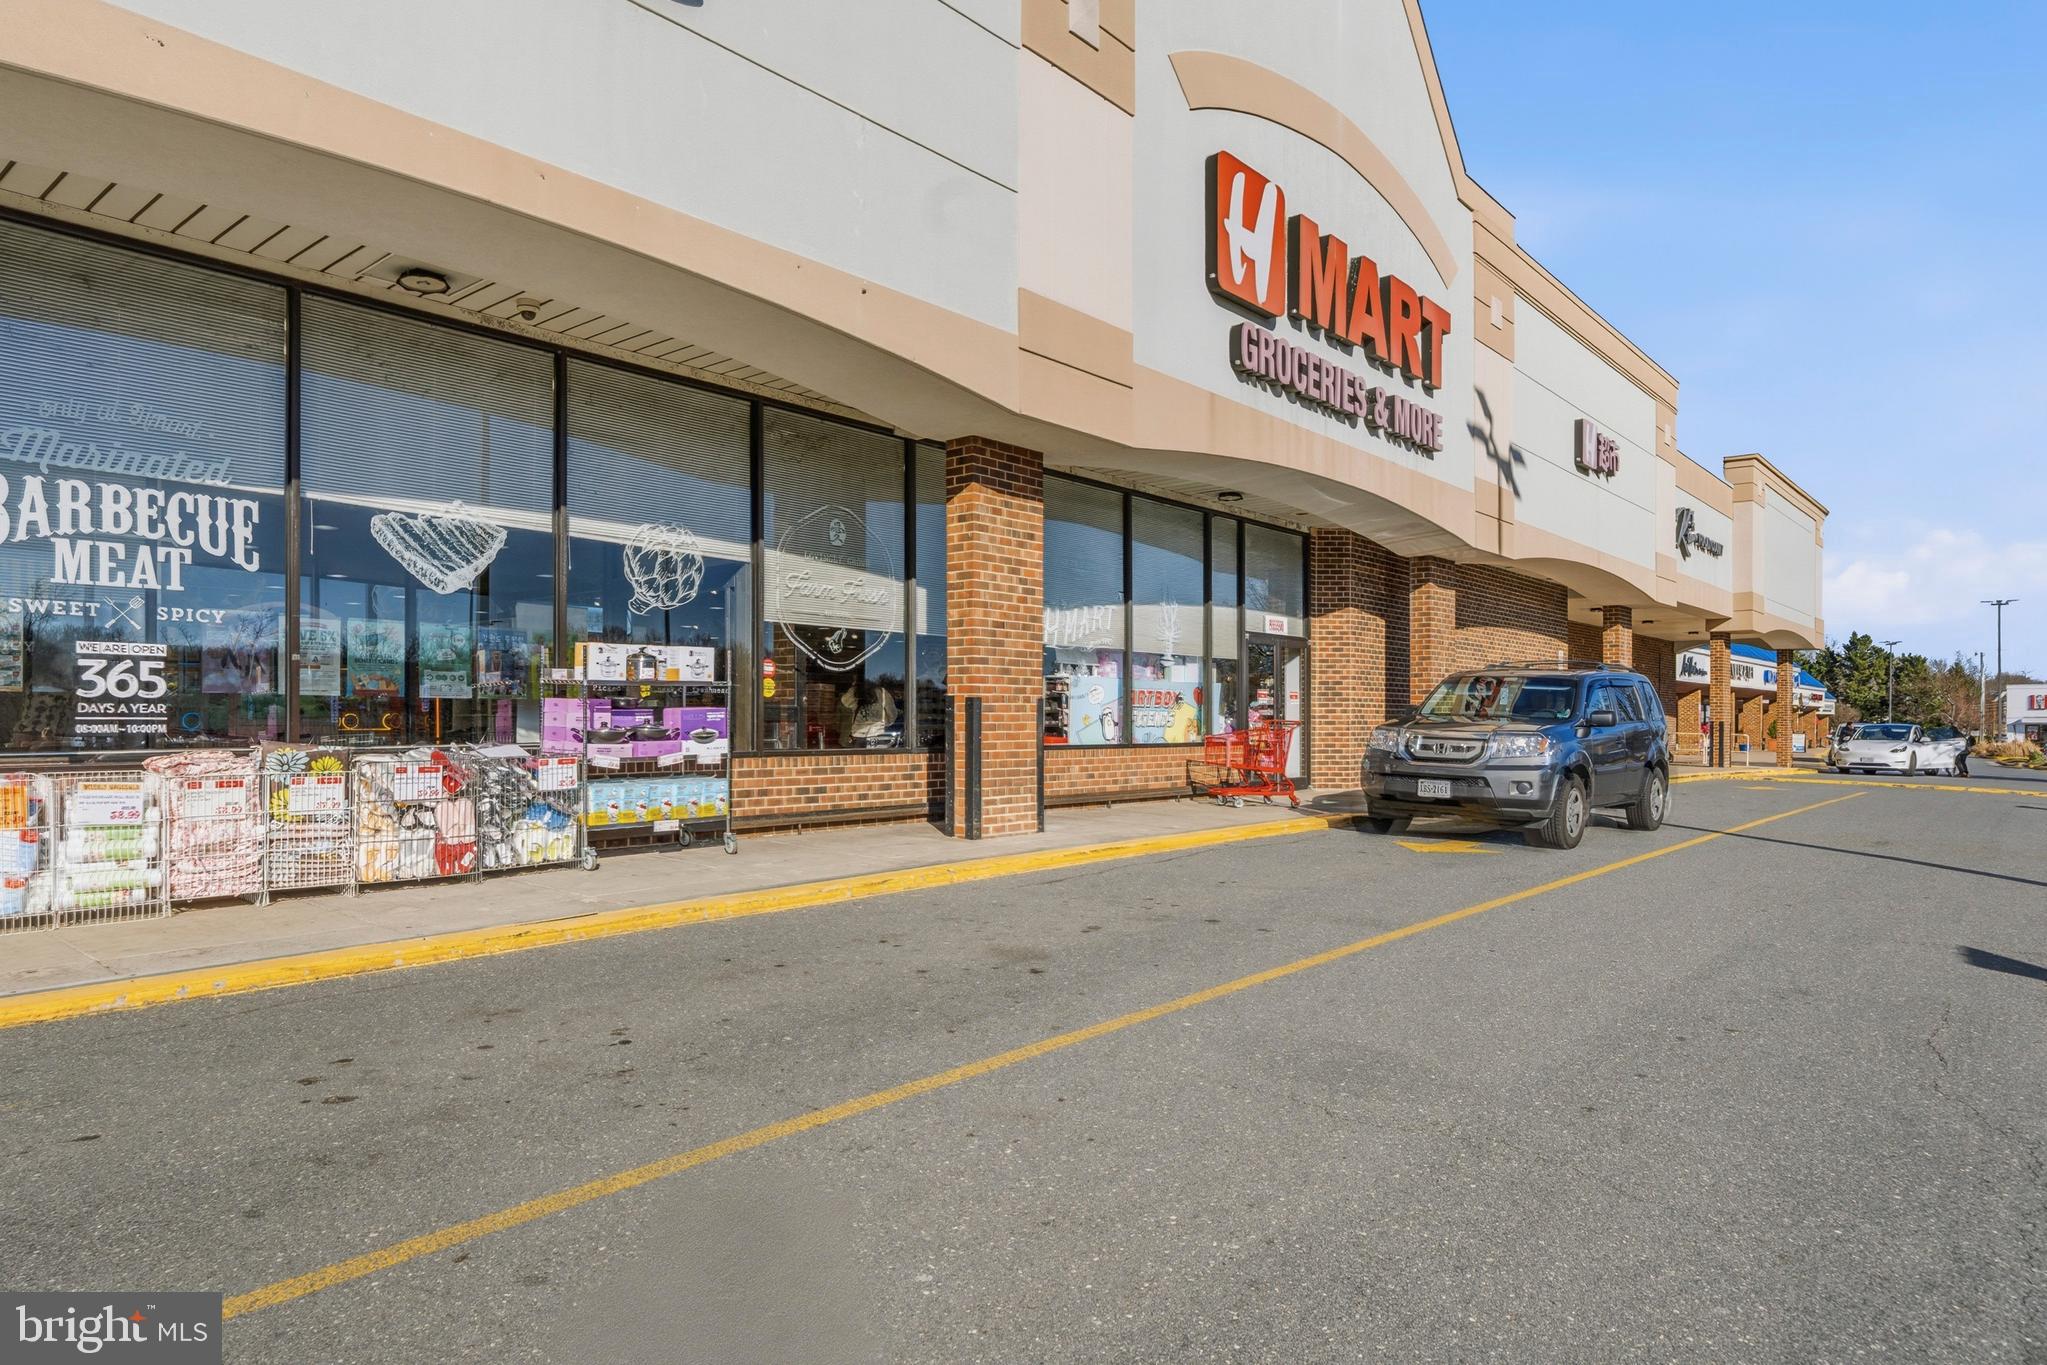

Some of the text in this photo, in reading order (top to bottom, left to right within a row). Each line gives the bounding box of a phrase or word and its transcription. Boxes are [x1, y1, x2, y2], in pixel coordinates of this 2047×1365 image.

[1221, 167, 1451, 390] H MART
[1234, 321, 1444, 452] GROCERIES & MORE
[0, 424, 236, 486] Marinated
[50, 537, 192, 591] MEAT
[8, 598, 226, 624] SWEET SPICY
[79, 643, 165, 654] WE ARE OPEN
[75, 659, 167, 698] 365
[77, 702, 167, 714] DAYS A YEAR
